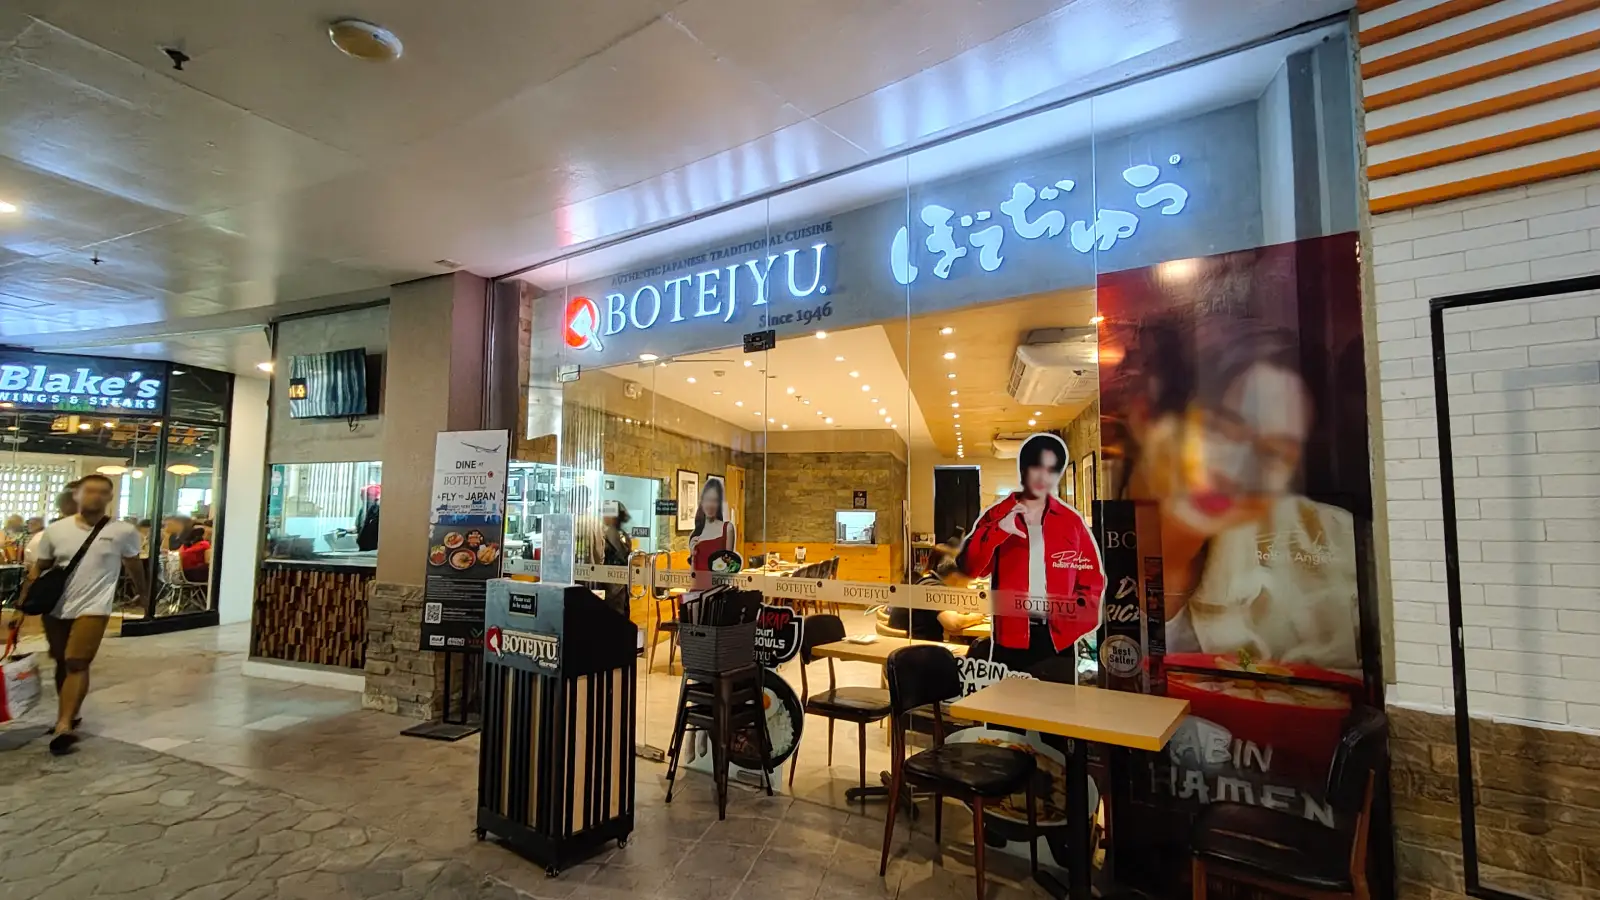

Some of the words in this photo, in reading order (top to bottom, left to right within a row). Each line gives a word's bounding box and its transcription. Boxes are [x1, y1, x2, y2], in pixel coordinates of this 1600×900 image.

[611, 267, 662, 286] AUTHENTIC
[661, 253, 708, 276] JAPANESE
[710, 235, 784, 262] TRADITIONAL
[784, 221, 833, 243] CUISINE
[758, 312, 793, 329] Since
[796, 301, 833, 326] 1946
[0, 365, 161, 398] Blake's
[0, 391, 60, 404] WINGS
[69, 396, 78, 405] &
[89, 396, 156, 409] STEAKS
[455, 460, 477, 469] DINE
[444, 475, 487, 487] BOTEJYU
[441, 492, 457, 501] FLY
[465, 491, 496, 501] JAPAN
[776, 582, 816, 595] BOTEJYU
[843, 586, 889, 600] BOTEJYU
[925, 592, 978, 606] BOTEJYU
[1015, 598, 1076, 615] BOTEJYU
[1112, 645, 1131, 656] Best
[1109, 654, 1136, 666] Seller
[955, 658, 1005, 680] RABIN
